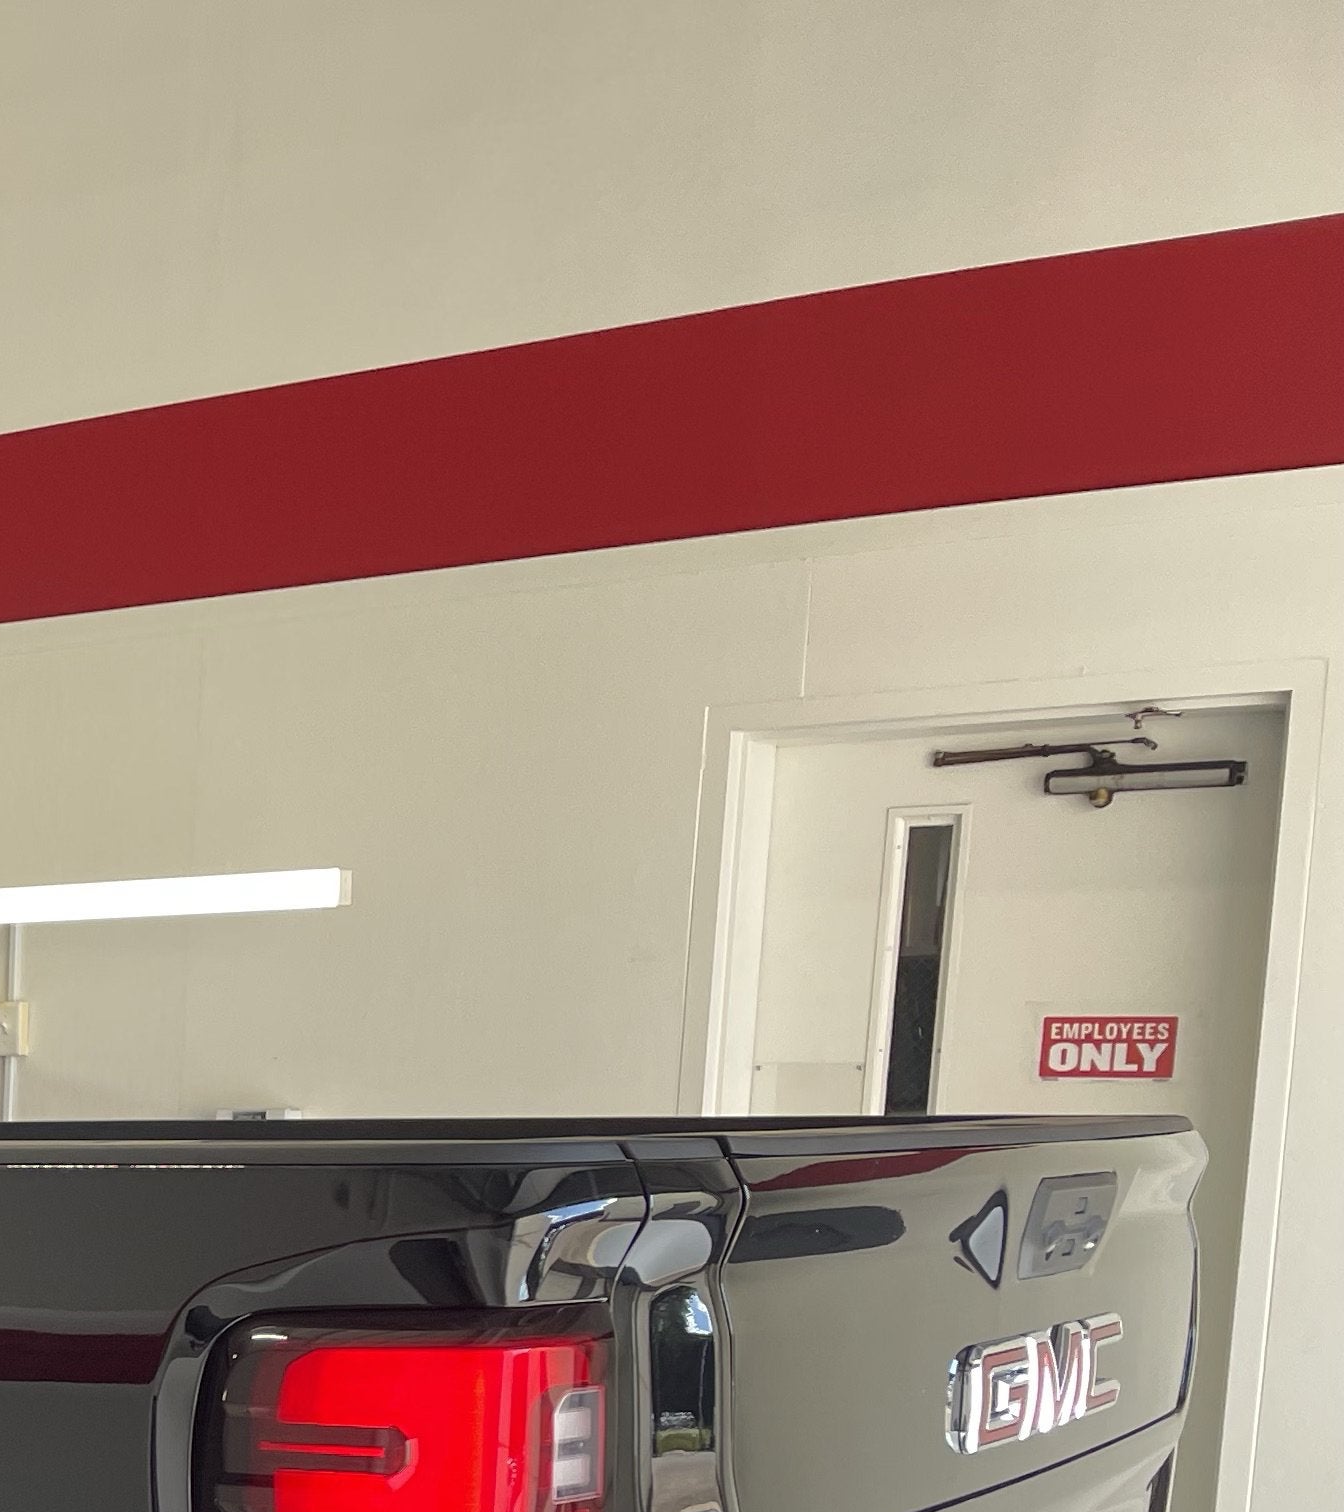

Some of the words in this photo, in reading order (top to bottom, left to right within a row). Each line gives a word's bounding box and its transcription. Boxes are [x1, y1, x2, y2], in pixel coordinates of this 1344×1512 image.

[1050, 1022, 1169, 1040] EMPLOYEES
[1048, 1042, 1169, 1072] ONLY
[945, 1312, 1124, 1454] GMC
